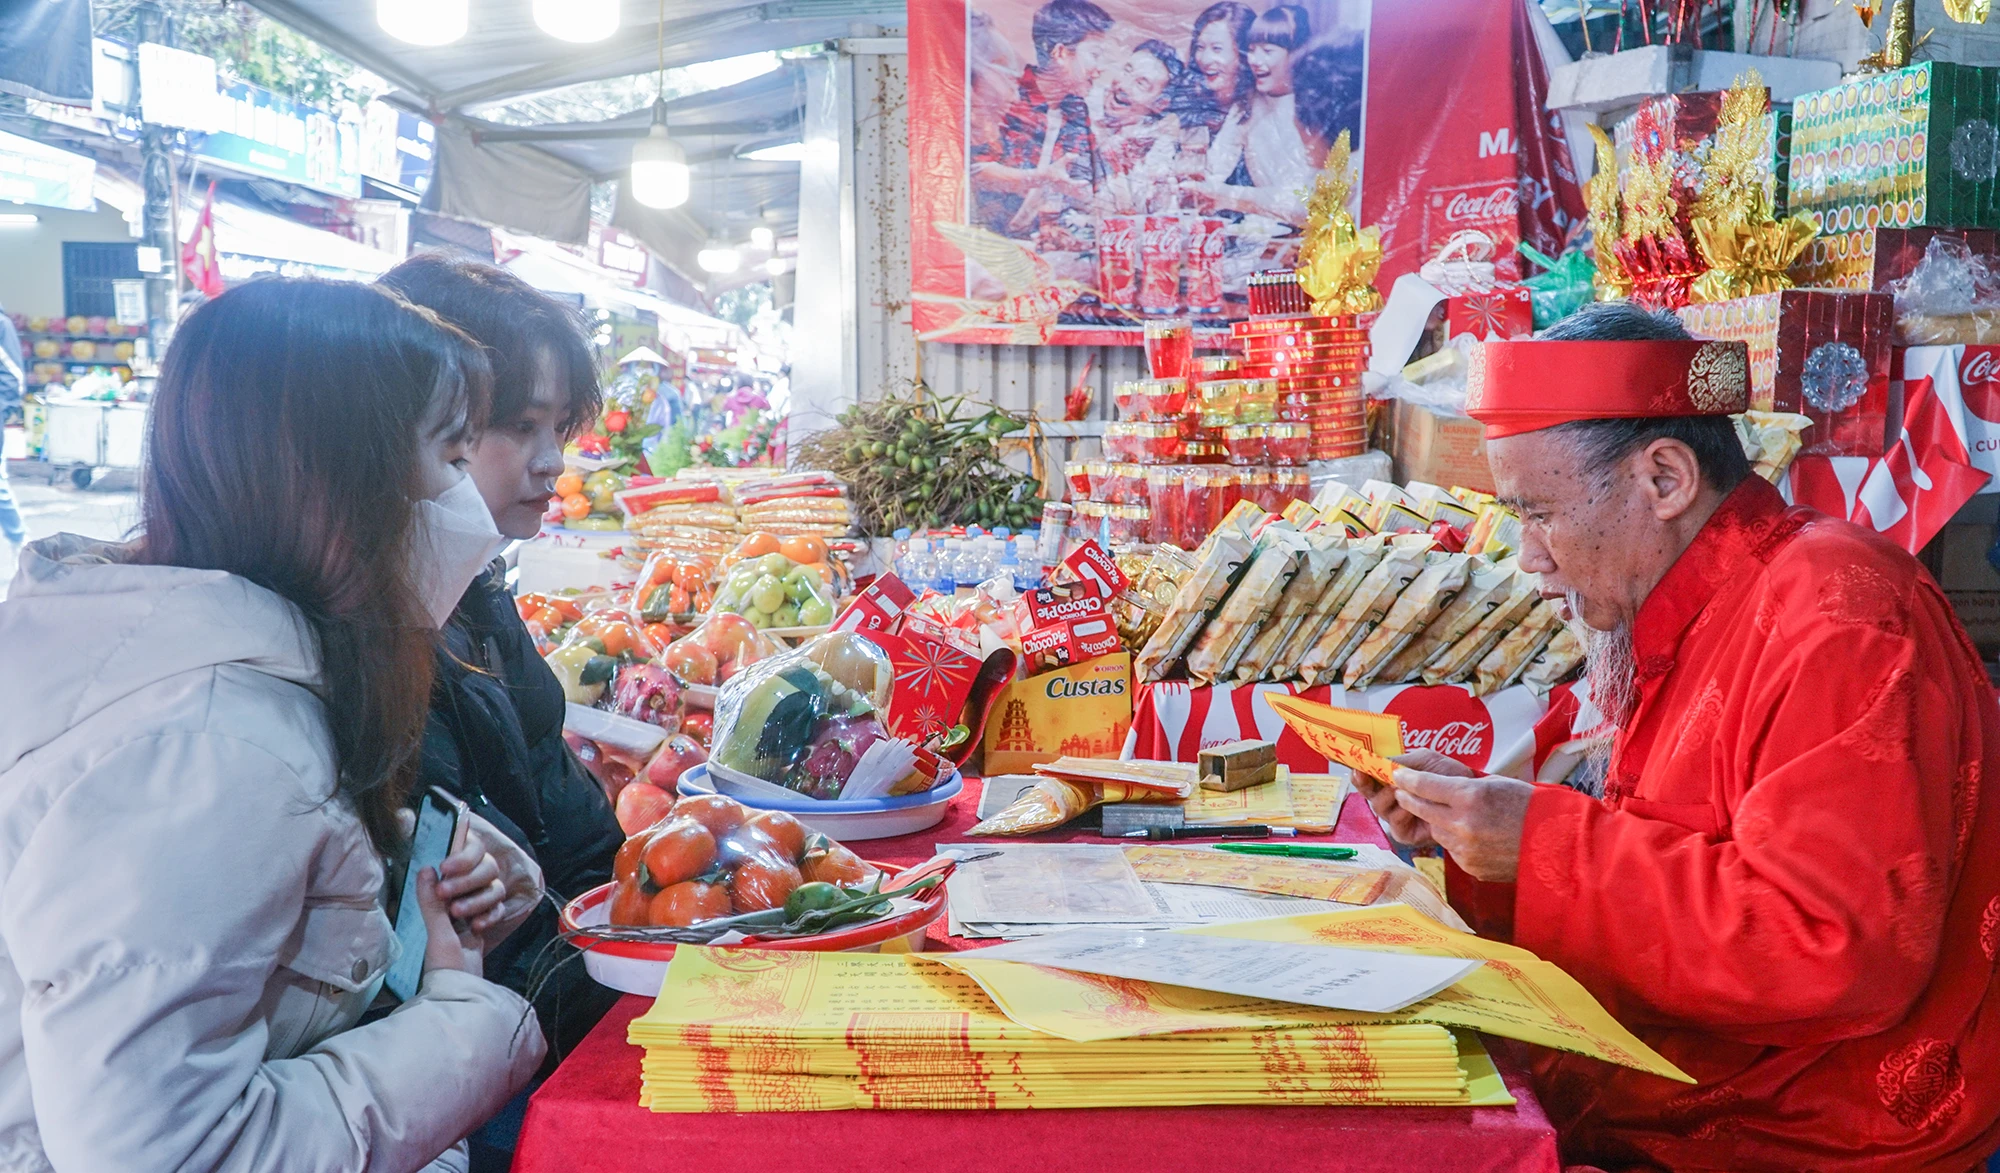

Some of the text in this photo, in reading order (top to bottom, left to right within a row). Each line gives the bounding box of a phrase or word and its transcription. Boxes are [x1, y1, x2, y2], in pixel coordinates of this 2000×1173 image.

[1975, 437, 2000, 453] CÙ
[1101, 664, 1125, 672] ORION
[1045, 676, 1126, 699] Custas
